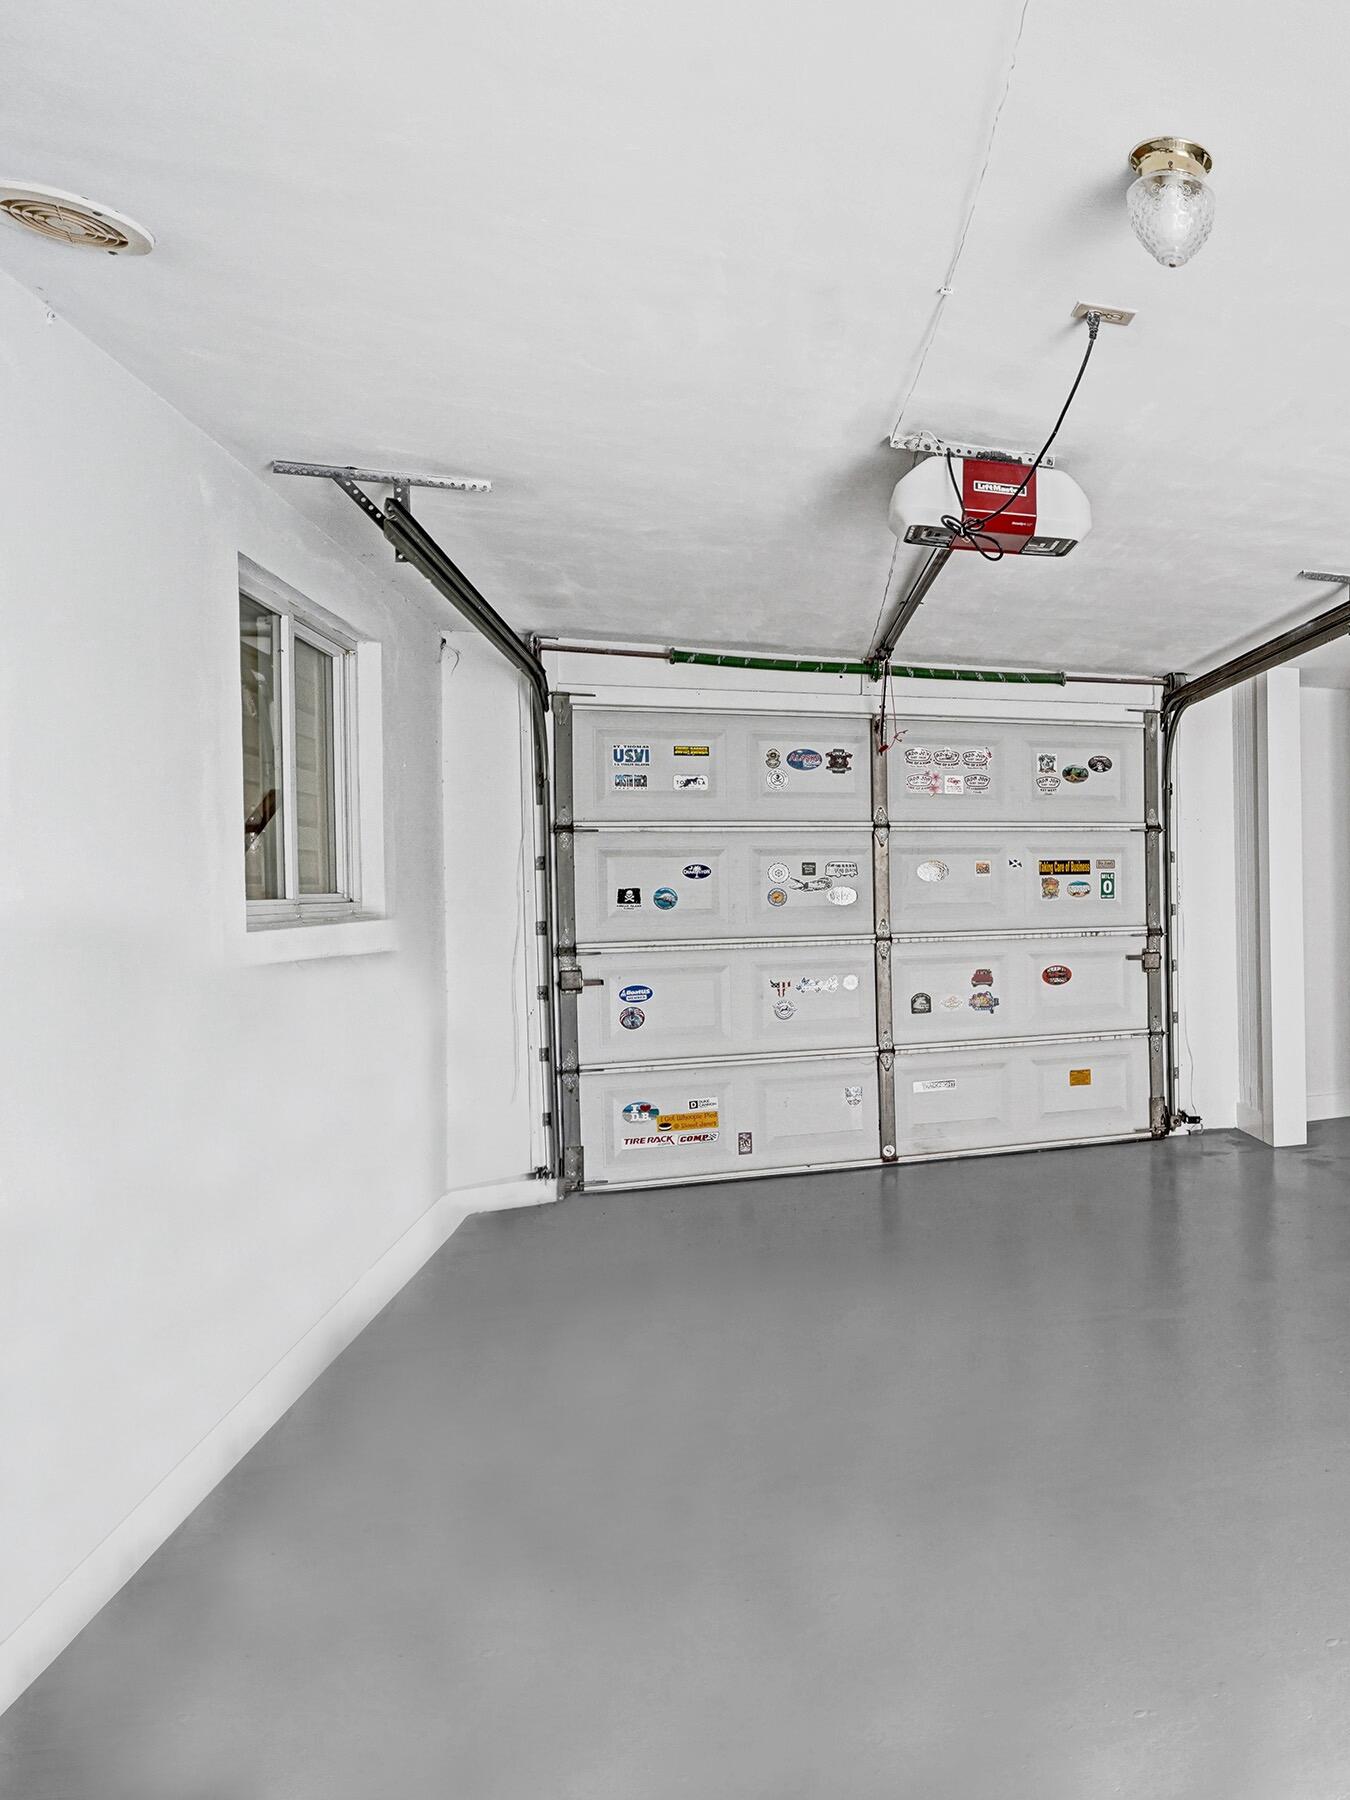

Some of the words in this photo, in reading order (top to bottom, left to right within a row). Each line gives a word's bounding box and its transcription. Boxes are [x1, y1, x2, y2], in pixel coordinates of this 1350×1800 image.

[613, 748, 650, 763] USVI
[1039, 861, 1053, 875] Taking
[1054, 861, 1064, 872] Care
[1065, 861, 1070, 872] of
[1071, 861, 1090, 873] Business
[1103, 880, 1113, 894] 0
[626, 988, 651, 996] BoatUS
[624, 1137, 645, 1145] TIRE
[646, 1135, 675, 1145] RACK
[679, 1134, 708, 1143] COMP
